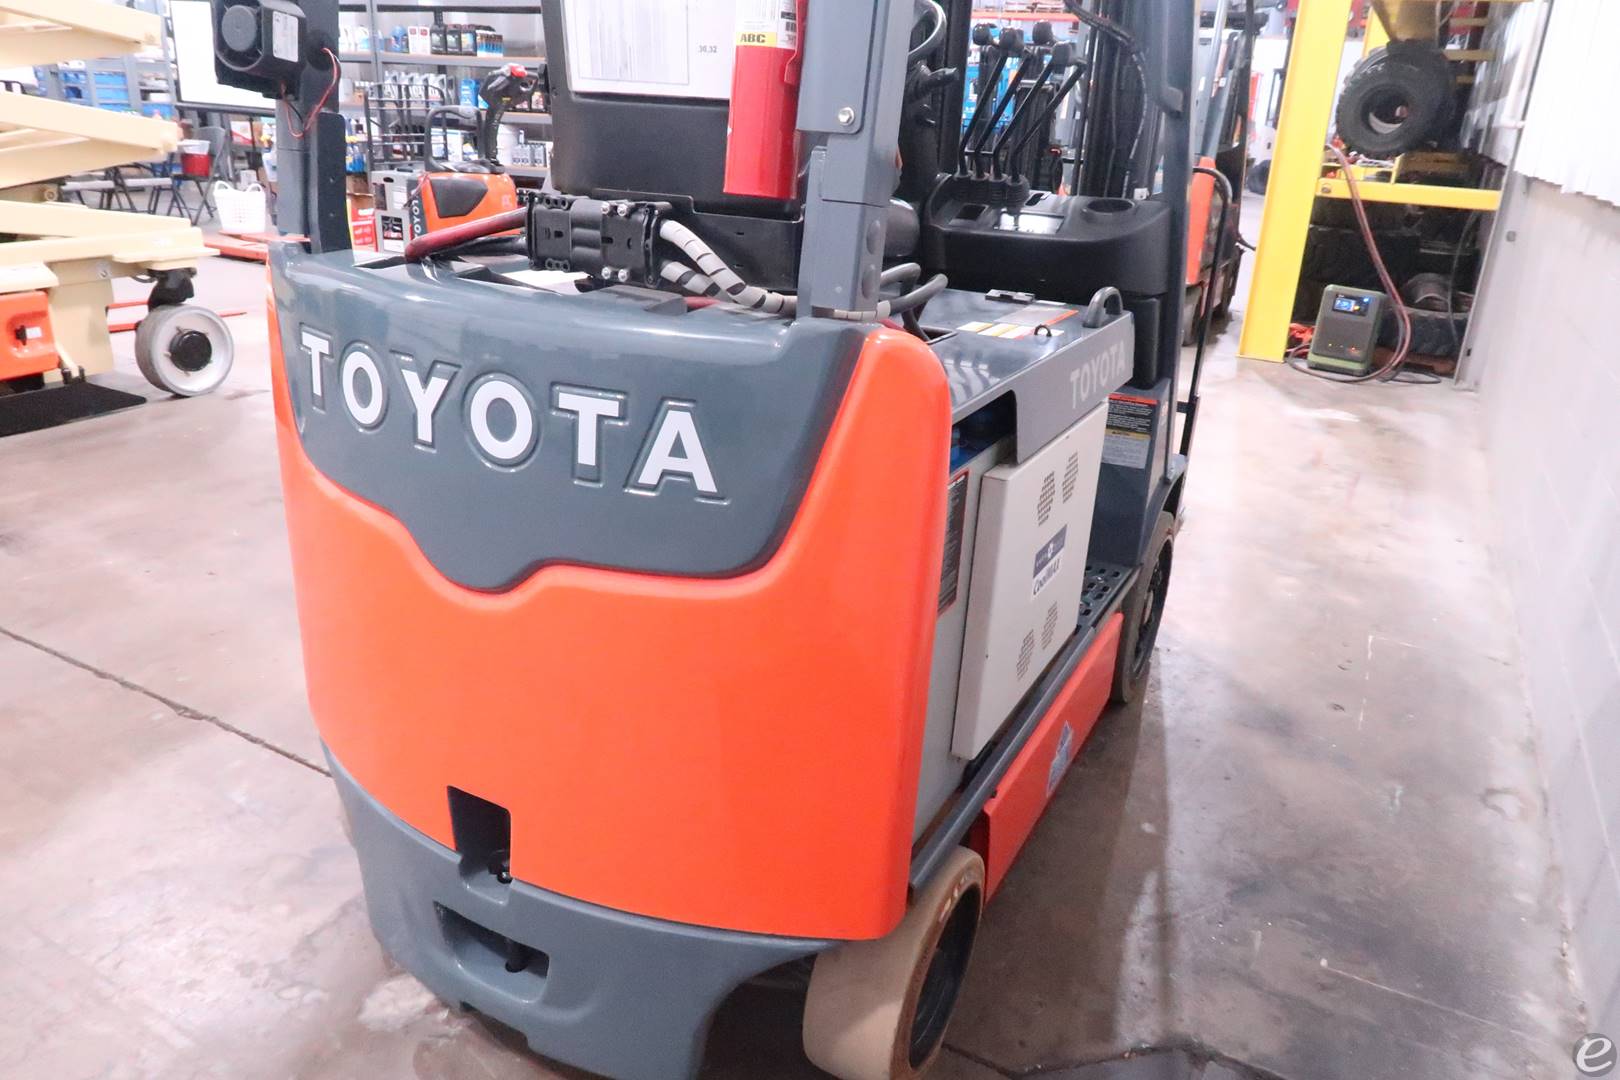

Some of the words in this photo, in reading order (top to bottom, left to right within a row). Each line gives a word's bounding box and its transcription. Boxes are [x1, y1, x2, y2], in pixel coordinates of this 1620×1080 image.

[740, 33, 766, 43] ABC
[1070, 340, 1126, 409] TOYOTA
[302, 331, 718, 493] TOYOTA
